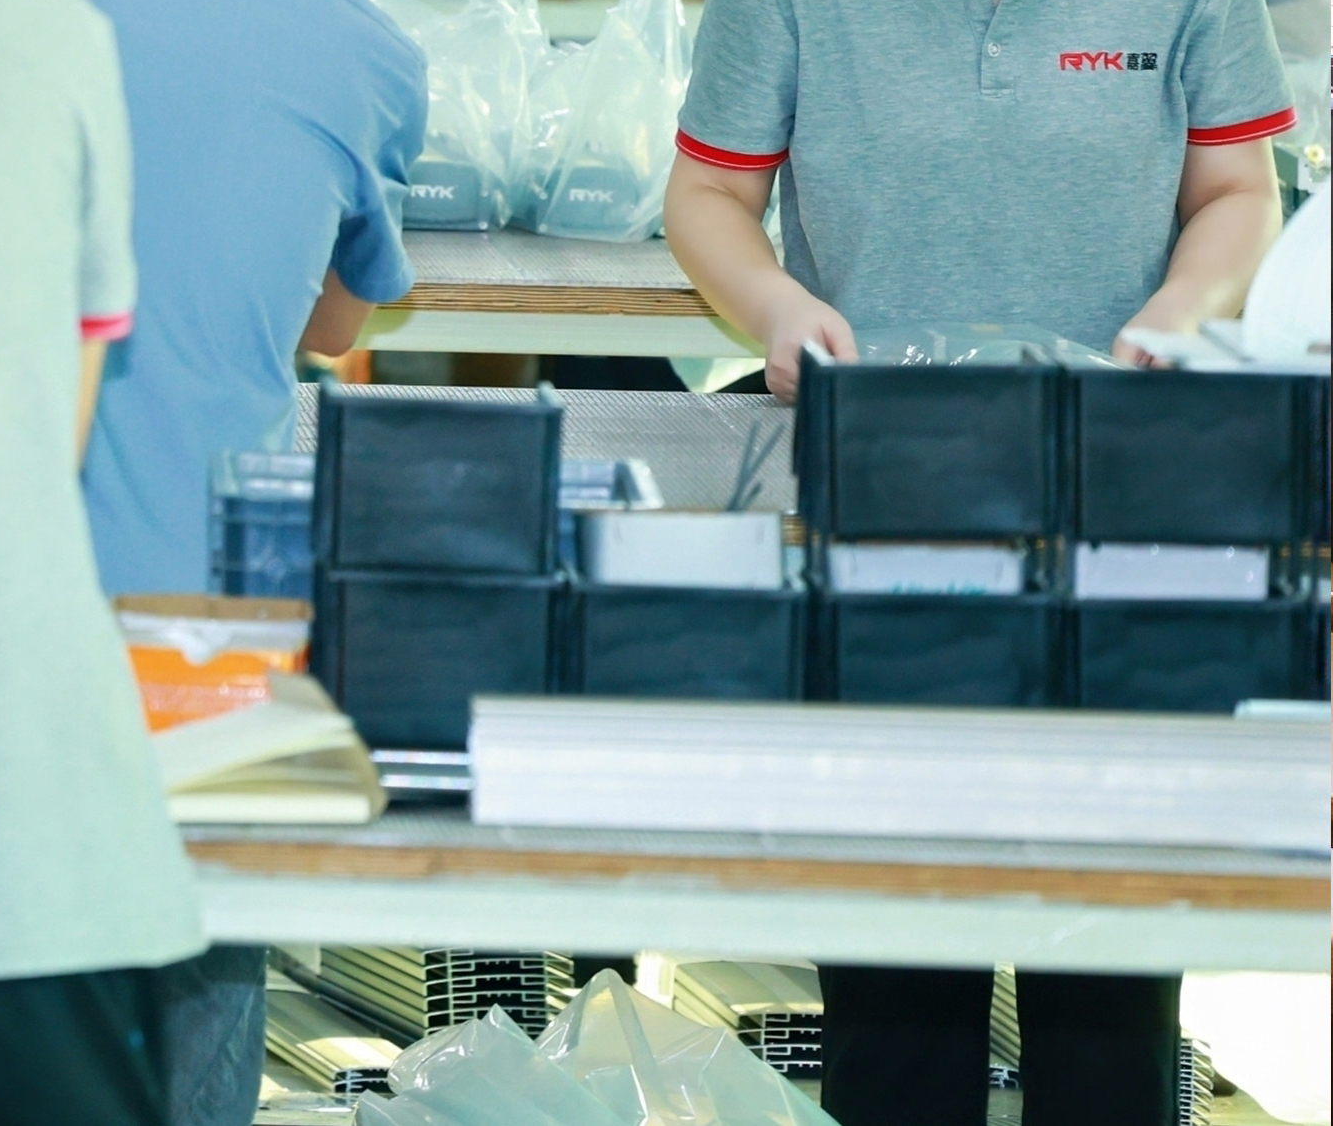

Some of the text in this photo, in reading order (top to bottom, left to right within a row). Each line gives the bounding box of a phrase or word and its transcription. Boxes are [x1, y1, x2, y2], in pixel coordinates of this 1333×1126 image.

[1059, 51, 1123, 71] RYK
[410, 184, 455, 200] RYK
[569, 187, 615, 204] RYK
